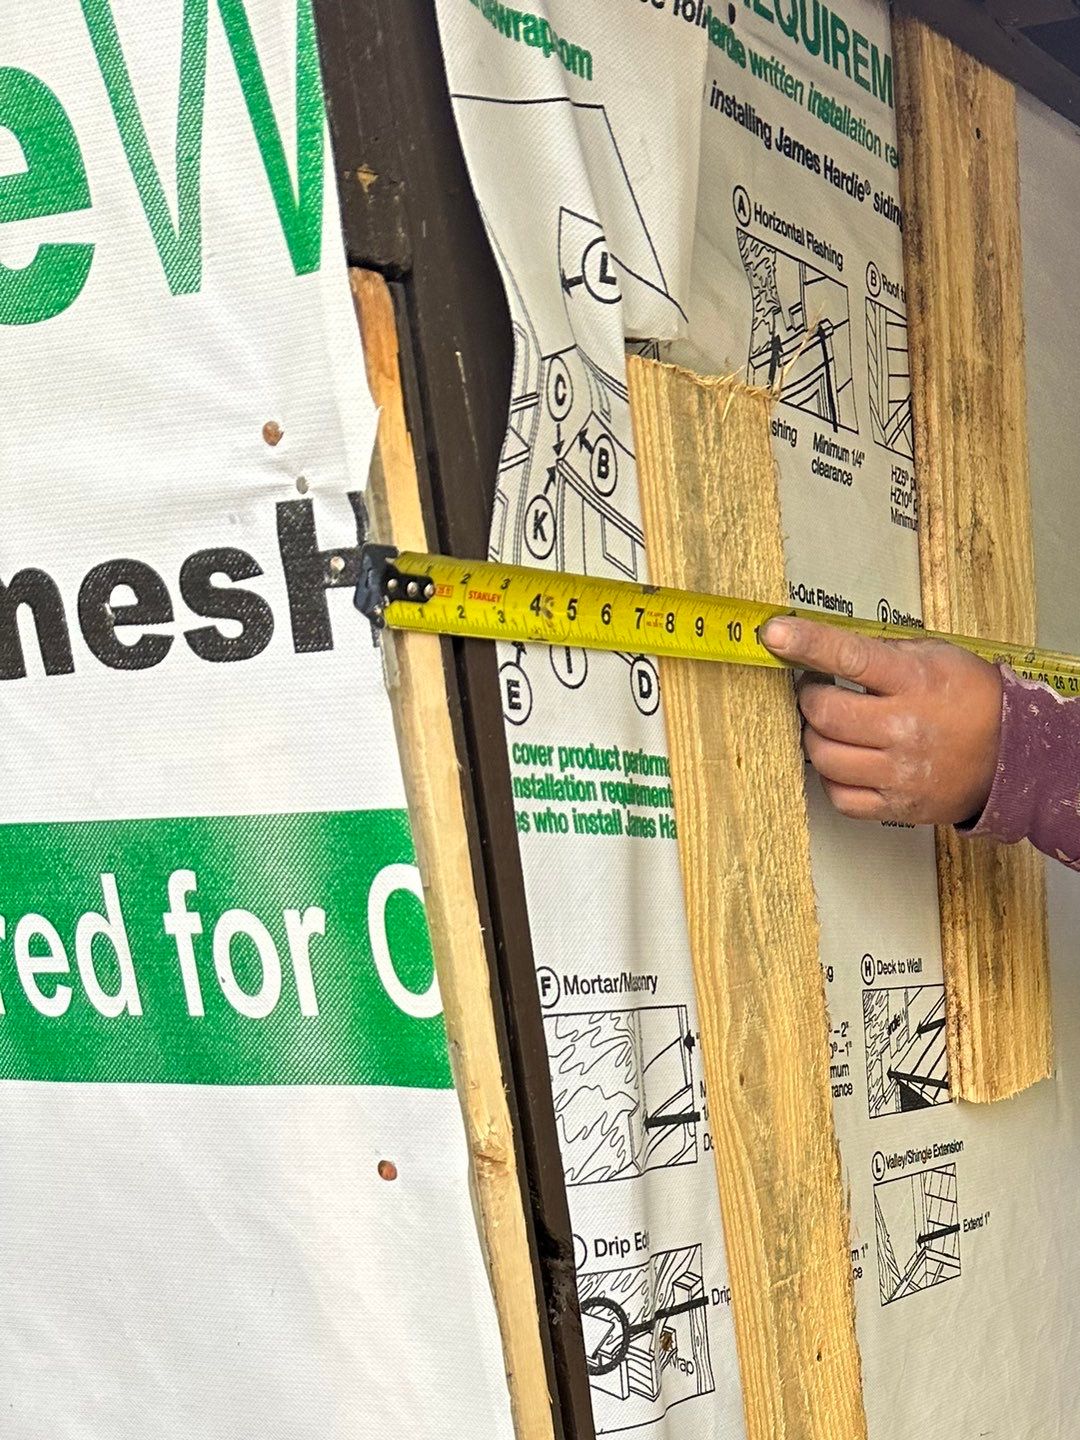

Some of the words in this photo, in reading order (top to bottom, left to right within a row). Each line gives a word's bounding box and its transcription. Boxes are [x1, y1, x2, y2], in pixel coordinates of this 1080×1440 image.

[748, 48, 804, 106] written
[807, 81, 882, 158] installation
[709, 80, 772, 150] installing
[775, 126, 821, 175] James
[754, 202, 805, 247] Horizontal
[807, 229, 844, 272] Flashing
[812, 432, 850, 465] Minimum
[811, 456, 853, 487] clearance
[460, 573, 470, 585] 2
[817, 589, 854, 617] Flashing
[457, 605, 465, 619] 2
[497, 610, 505, 623] 3
[530, 593, 541, 617] 4
[567, 598, 578, 621] 5
[601, 603, 611, 625] 6
[635, 607, 645, 630] 7
[665, 612, 674, 634] 8
[695, 616, 704, 637] 9
[727, 620, 742, 642] 10
[1053, 676, 1065, 690] 26
[1068, 678, 1078, 692] 27
[512, 742, 555, 767] cover
[558, 743, 622, 773] product
[513, 773, 598, 801] nstallation
[533, 807, 569, 835] who
[572, 808, 623, 836] install
[0, 873, 143, 1020] ed
[163, 869, 326, 1020] for
[877, 959, 897, 976] Deck
[898, 960, 906, 974] to
[906, 957, 922, 974] Wall
[884, 1148, 933, 1170] Valley/Shingle
[933, 1139, 965, 1159] Extension
[963, 1215, 983, 1233] Extend
[594, 1236, 631, 1259] Drip
